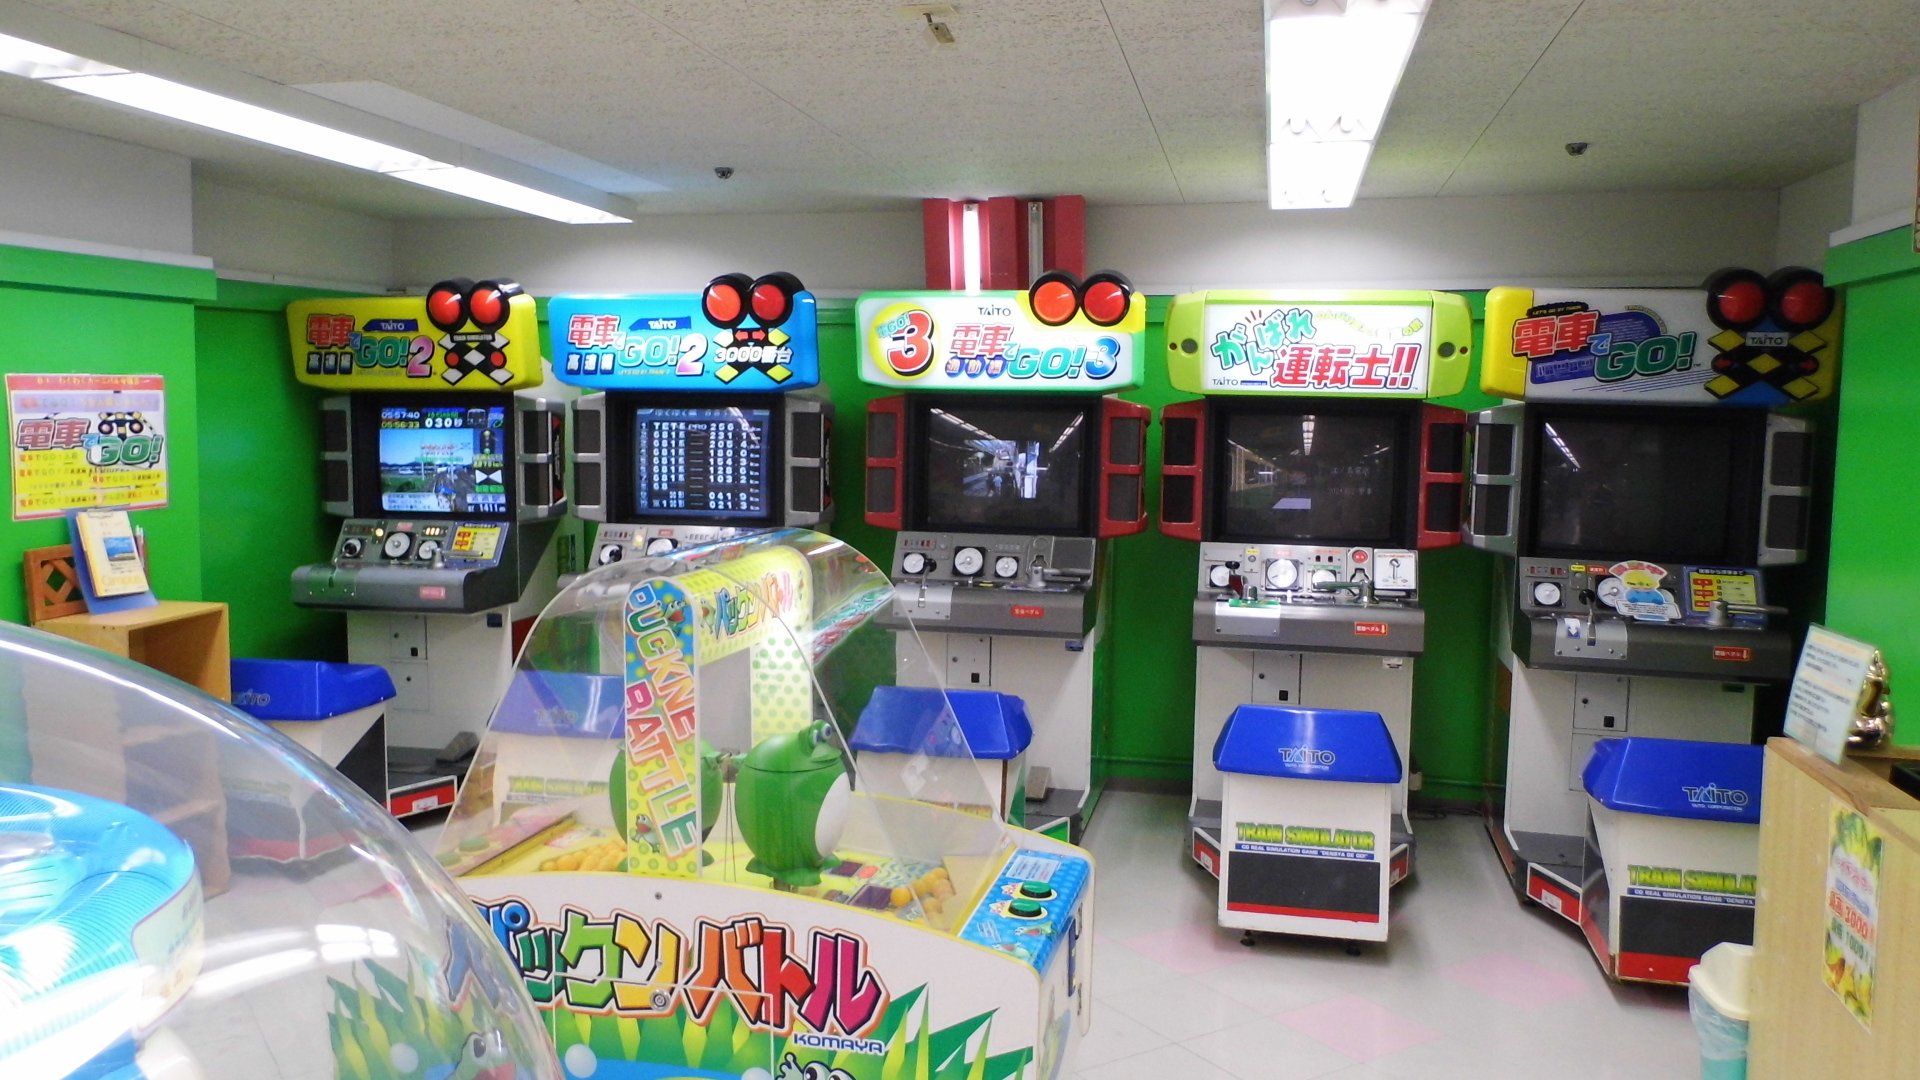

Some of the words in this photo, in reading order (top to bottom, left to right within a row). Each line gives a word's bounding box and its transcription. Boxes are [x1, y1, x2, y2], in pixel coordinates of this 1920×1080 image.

[978, 305, 1011, 317] TAITO
[380, 321, 405, 331] TAITO
[648, 319, 677, 329] TAITO
[1211, 308, 1316, 375] がんばれ
[1513, 310, 1697, 382] 電車でGO!
[1750, 334, 1783, 346] TAITO
[1271, 344, 1421, 389] 運転士!!
[1212, 377, 1239, 386] TAITO
[1278, 744, 1336, 766] TAITO
[625, 679, 696, 858] BATTLE
[1681, 782, 1749, 806] TAITO
[1236, 822, 1284, 845] TRAIN
[1284, 826, 1376, 851] SIMULATOR
[1627, 864, 1682, 889] TRAIN
[794, 1032, 885, 1054] KOMAYA
